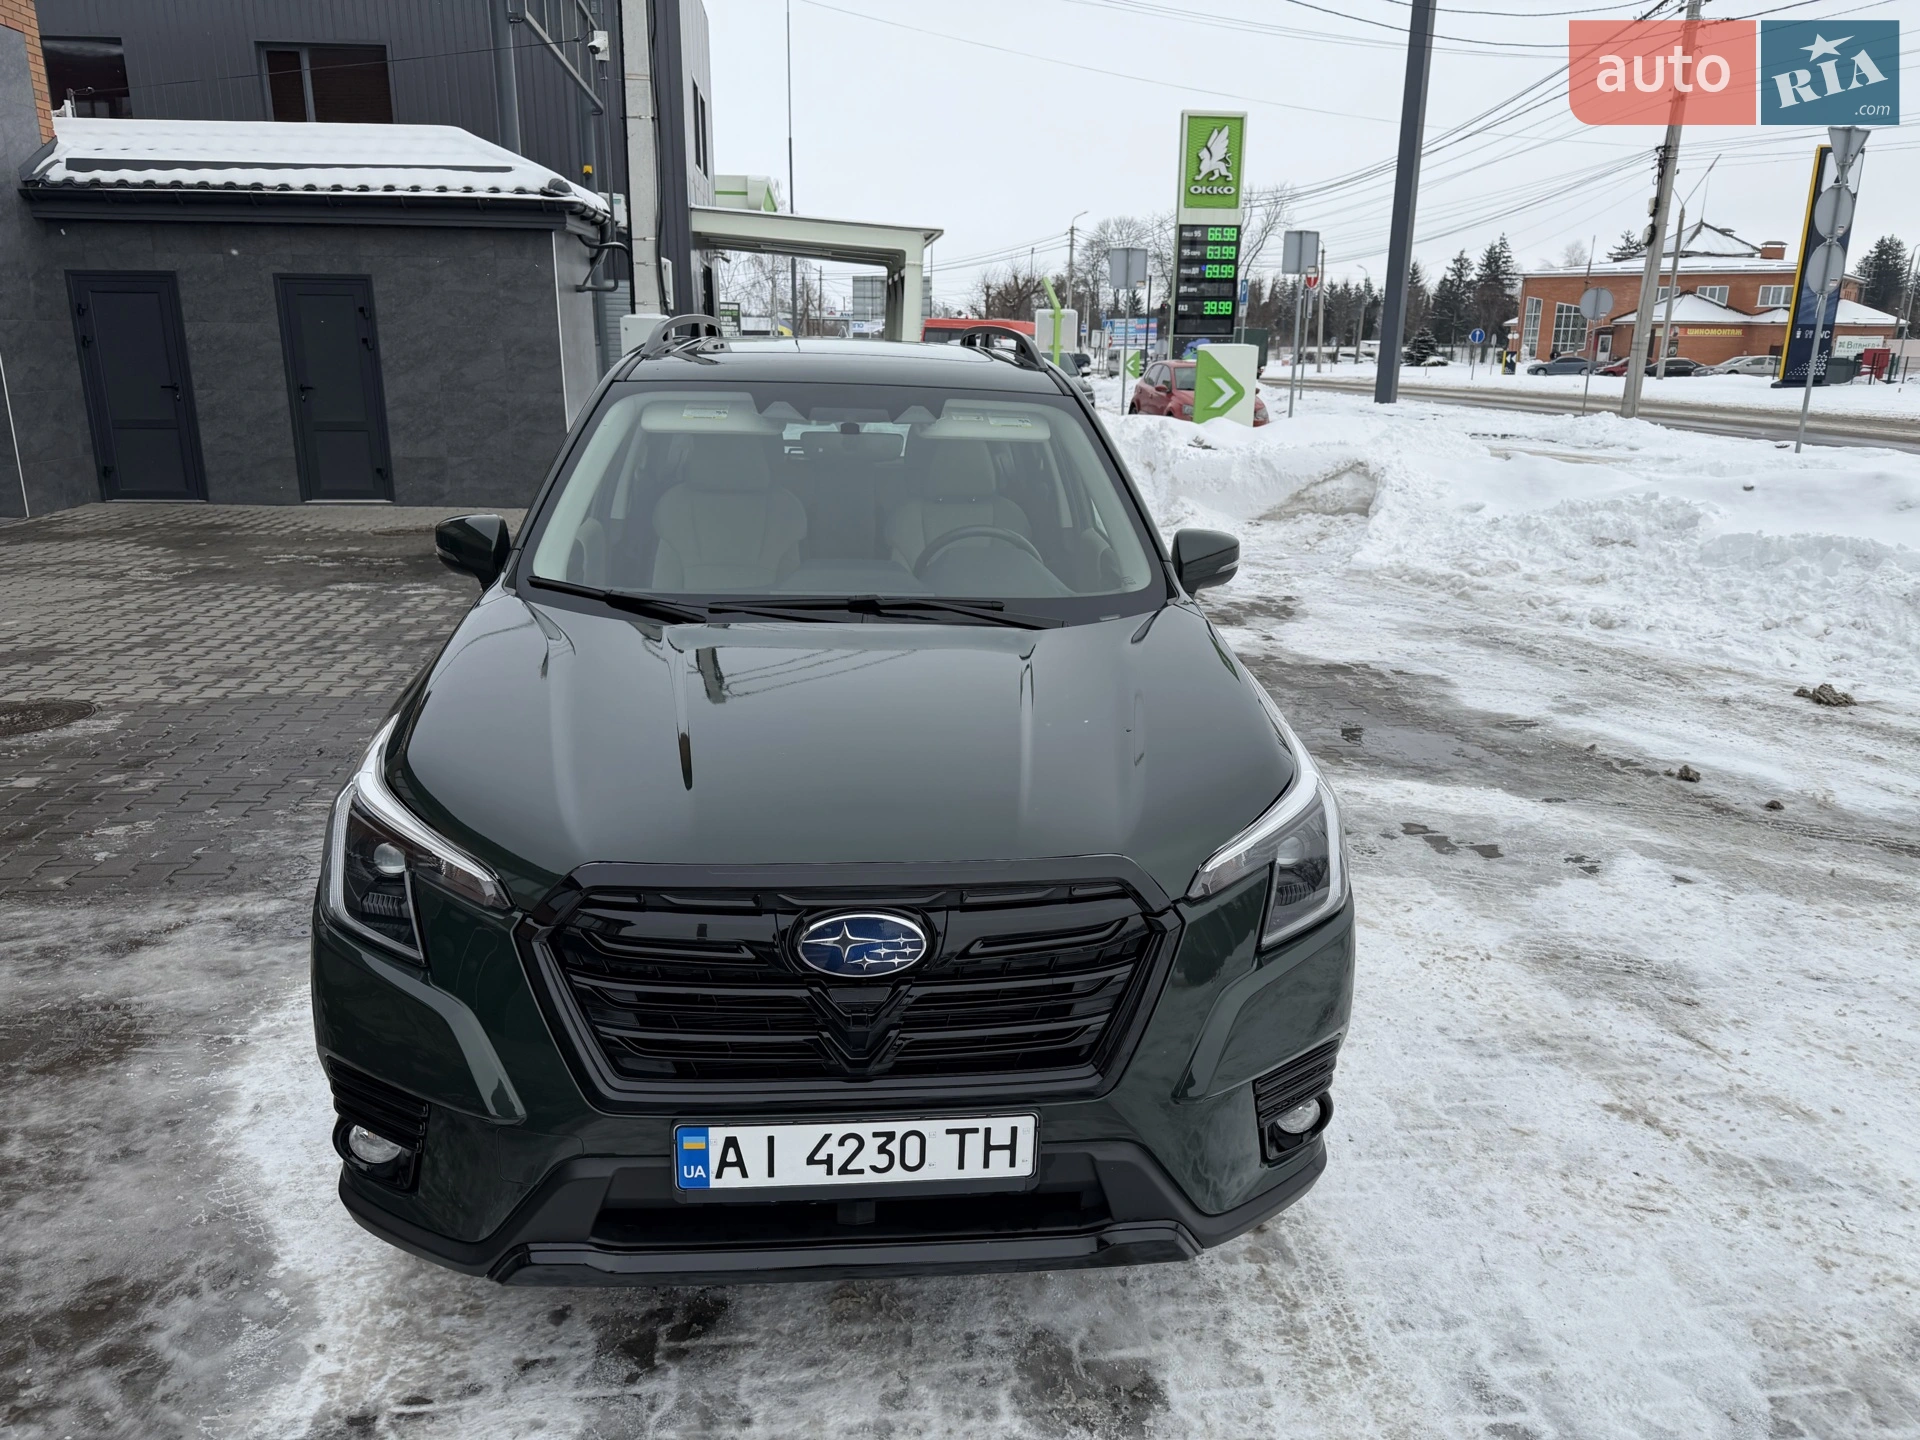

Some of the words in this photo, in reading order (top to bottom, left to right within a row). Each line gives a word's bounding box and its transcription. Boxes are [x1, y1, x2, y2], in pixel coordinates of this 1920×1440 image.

[1190, 185, 1236, 195] OKKO
[1208, 227, 1238, 241] 66.99
[1206, 245, 1236, 259] 63.99
[1205, 264, 1235, 278] 69.99
[1203, 301, 1233, 315] 39.99
[1687, 328, 1743, 336] ШИНОМОНТАЖ
[806, 1129, 927, 1176] 4230
[945, 1126, 1018, 1170] TH
[683, 1165, 707, 1179] UA
